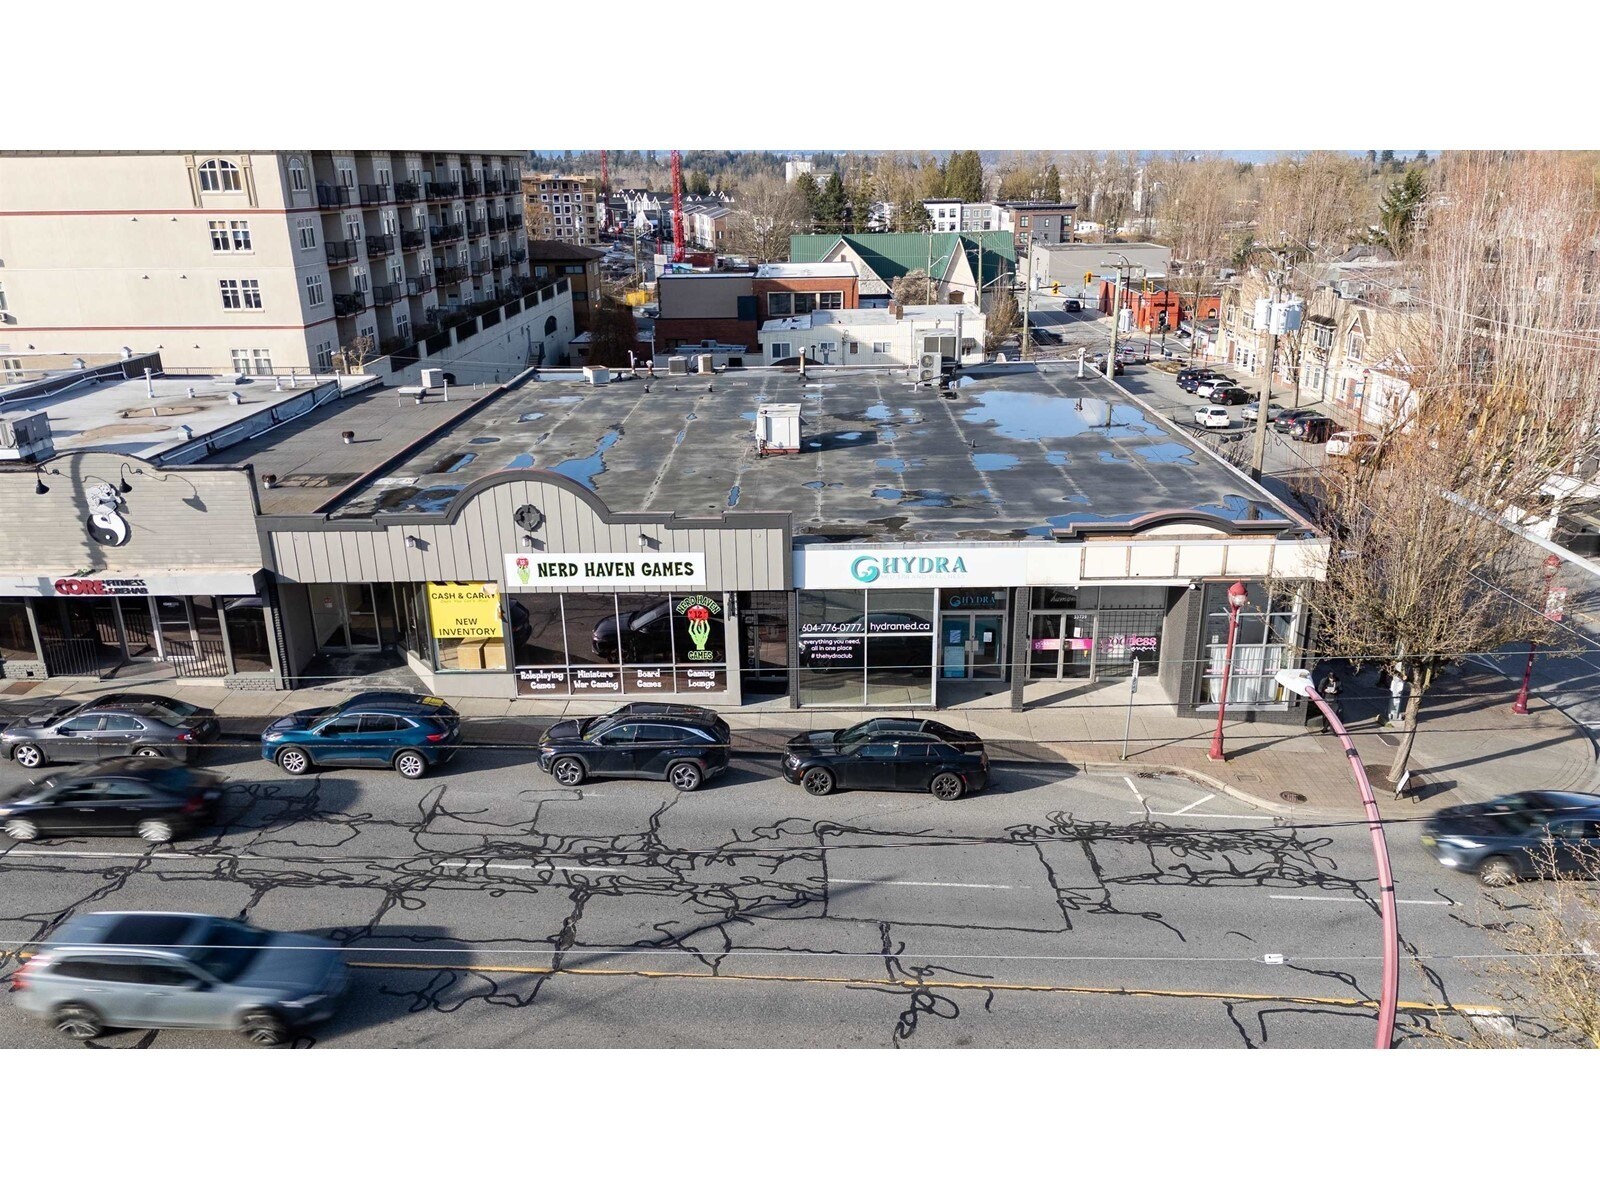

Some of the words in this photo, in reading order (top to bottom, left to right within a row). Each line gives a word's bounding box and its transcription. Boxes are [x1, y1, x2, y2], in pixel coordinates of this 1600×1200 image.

[538, 562, 578, 577] NERD
[584, 562, 634, 577] HAVEN
[642, 562, 694, 577] GAMES
[882, 556, 968, 574] HYDRA
[55, 579, 105, 595] CORE
[676, 596, 696, 614] NERD
[697, 595, 721, 614] HAVEN
[801, 624, 862, 632] 604-776-0777
[870, 622, 930, 632] hydramed.ca
[688, 650, 713, 660] GAMES
[520, 670, 564, 681] Roleplaying
[577, 670, 613, 678] Miniature
[637, 669, 660, 678] Board
[687, 669, 715, 679] Gaming
[590, 680, 618, 690] Gaming
[637, 680, 662, 688] Games
[688, 679, 715, 689] Lounge
